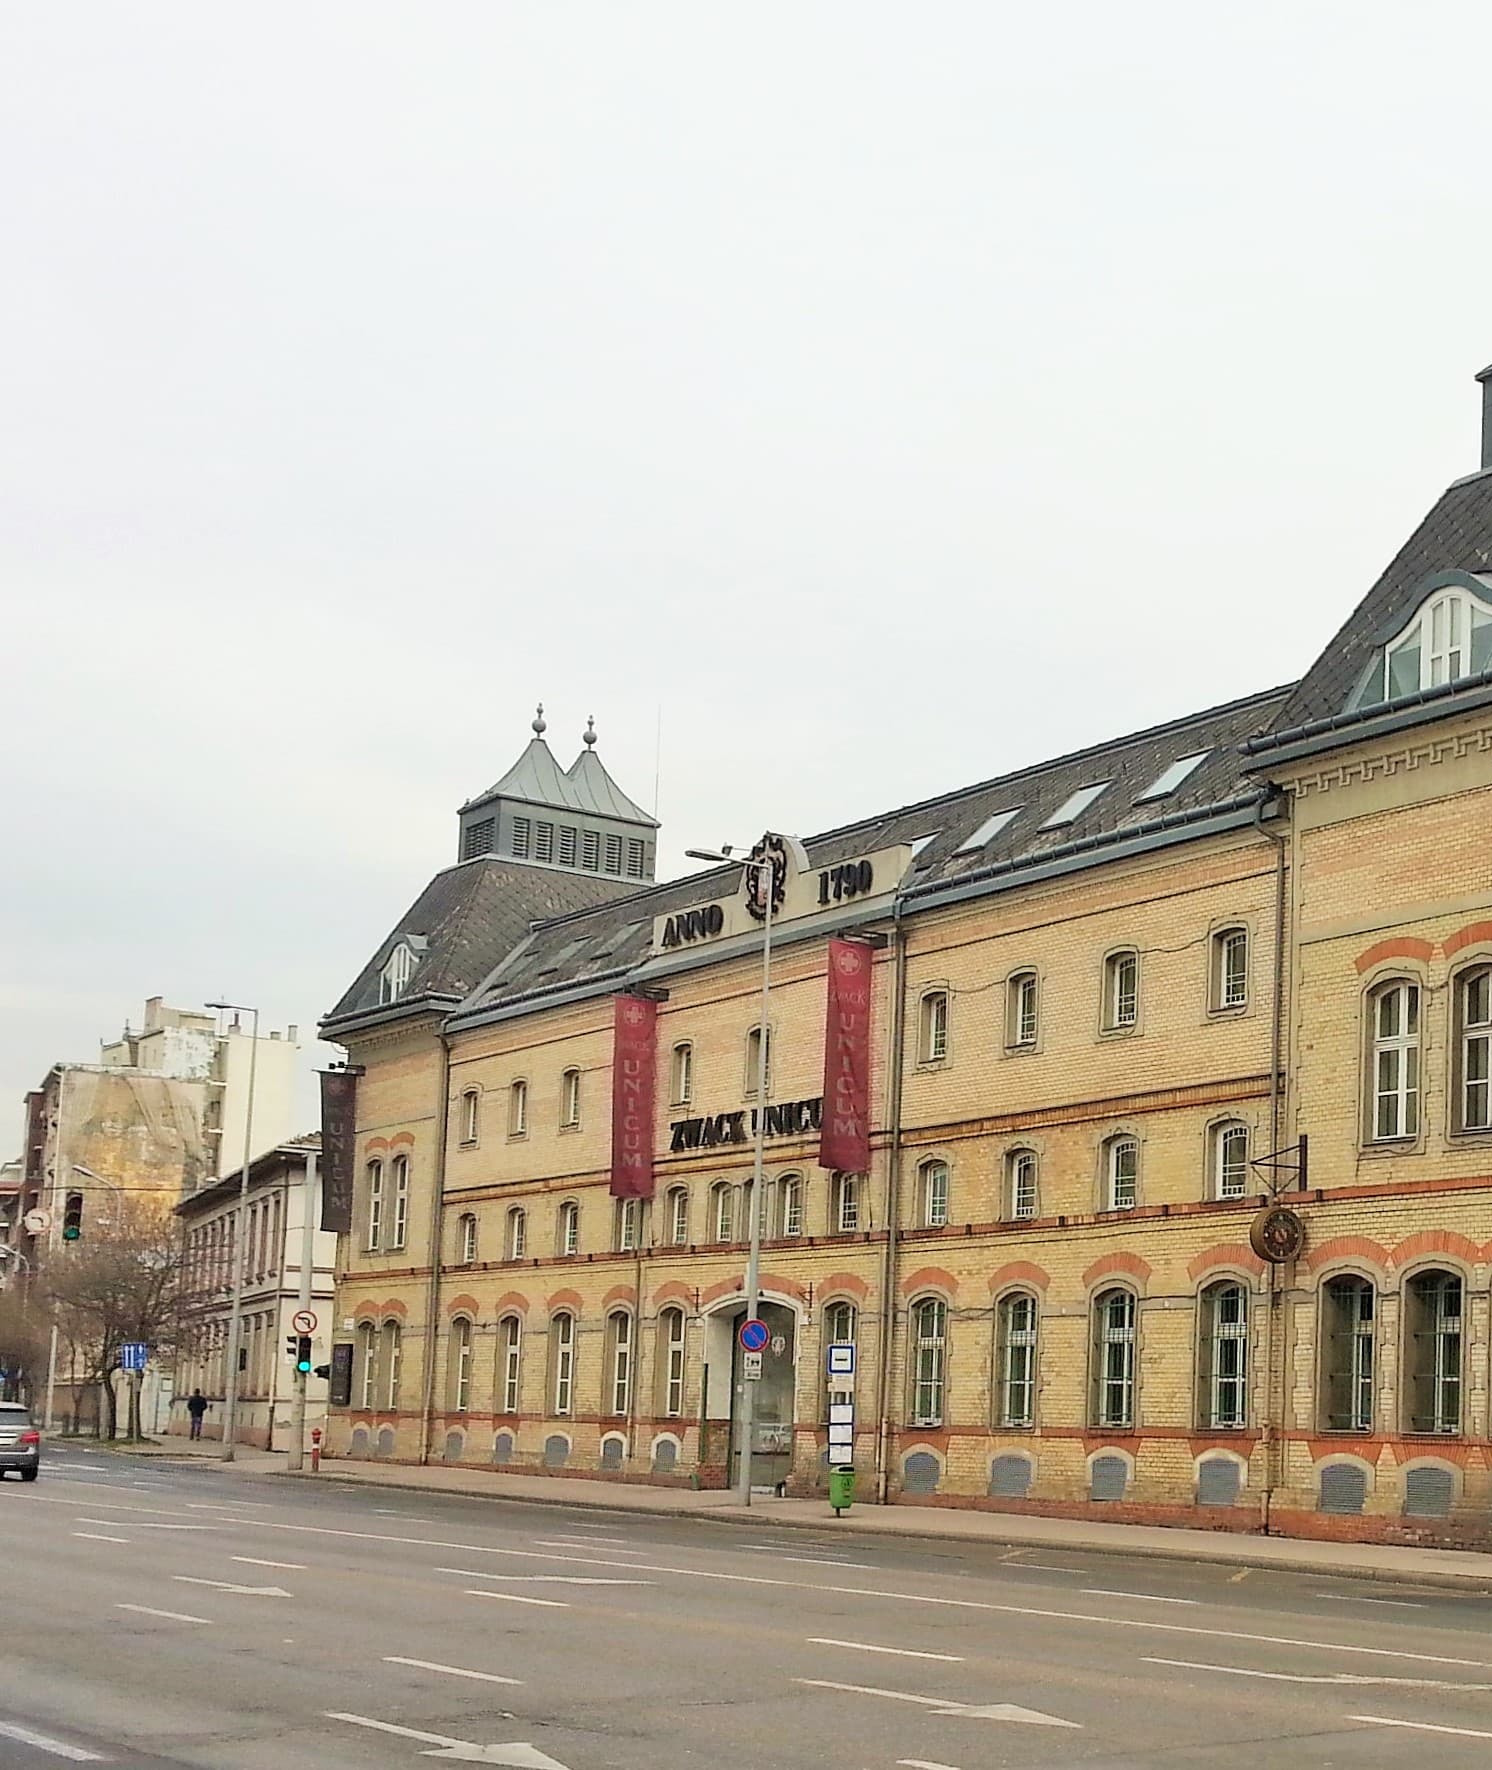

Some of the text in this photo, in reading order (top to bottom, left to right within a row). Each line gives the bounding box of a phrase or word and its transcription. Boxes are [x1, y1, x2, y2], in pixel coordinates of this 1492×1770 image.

[661, 860, 873, 947] ANNO 1790
[622, 1059, 643, 1168] UNICUM
[832, 1012, 858, 1137] UNICUM
[670, 1098, 823, 1152] ZWACK UNICU
